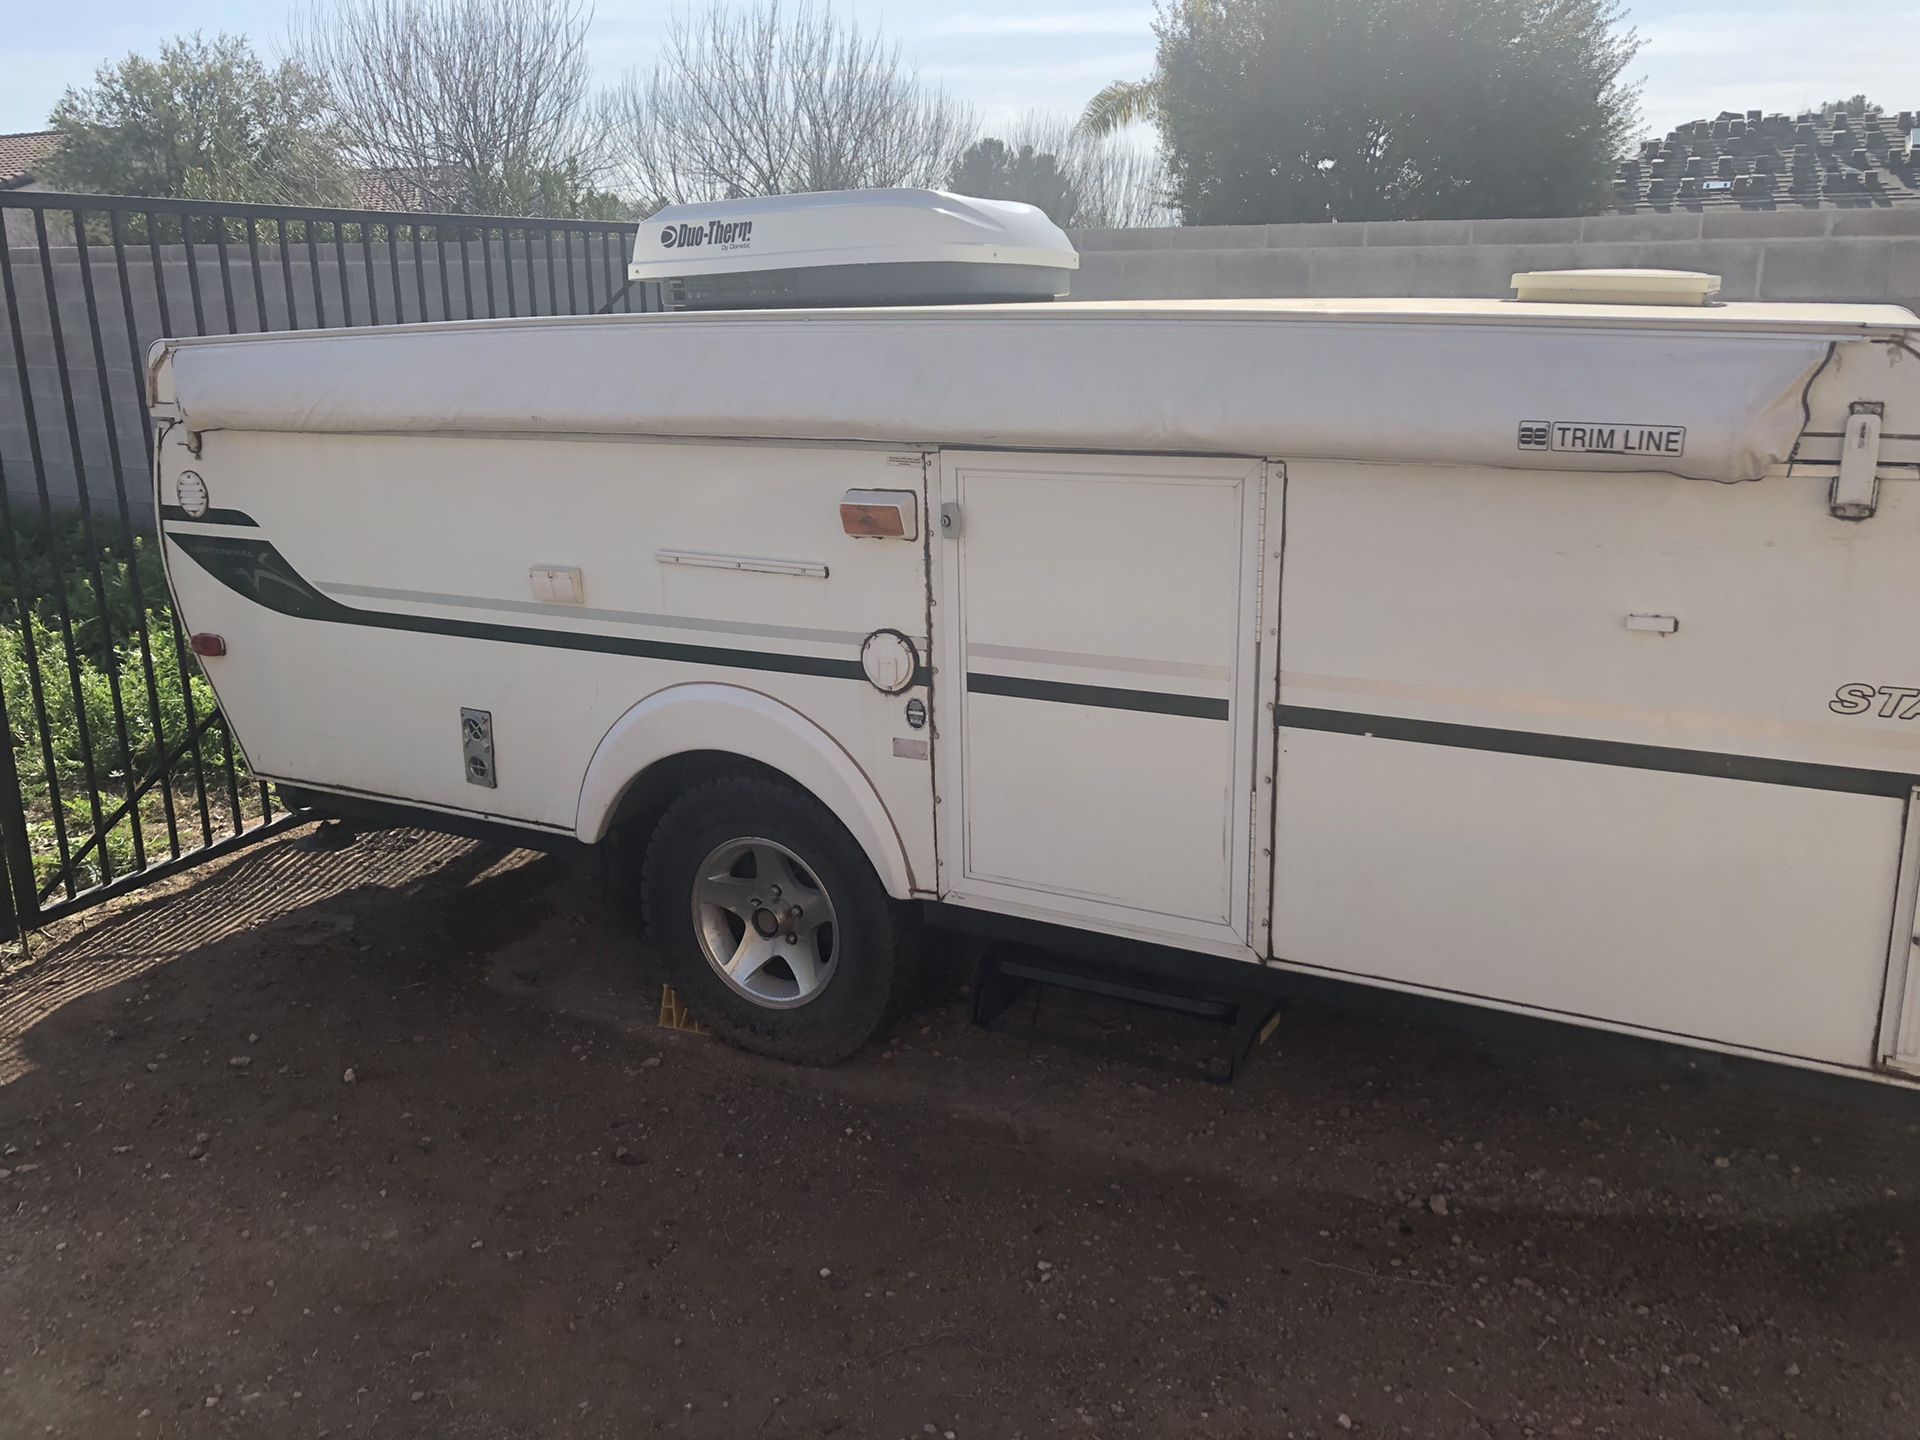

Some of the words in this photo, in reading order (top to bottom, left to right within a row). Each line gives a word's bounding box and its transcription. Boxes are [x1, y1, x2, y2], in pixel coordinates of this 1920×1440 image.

[677, 219, 753, 248] Duo-Therm
[1557, 427, 1616, 449] TRIM
[1623, 429, 1682, 452] LINE
